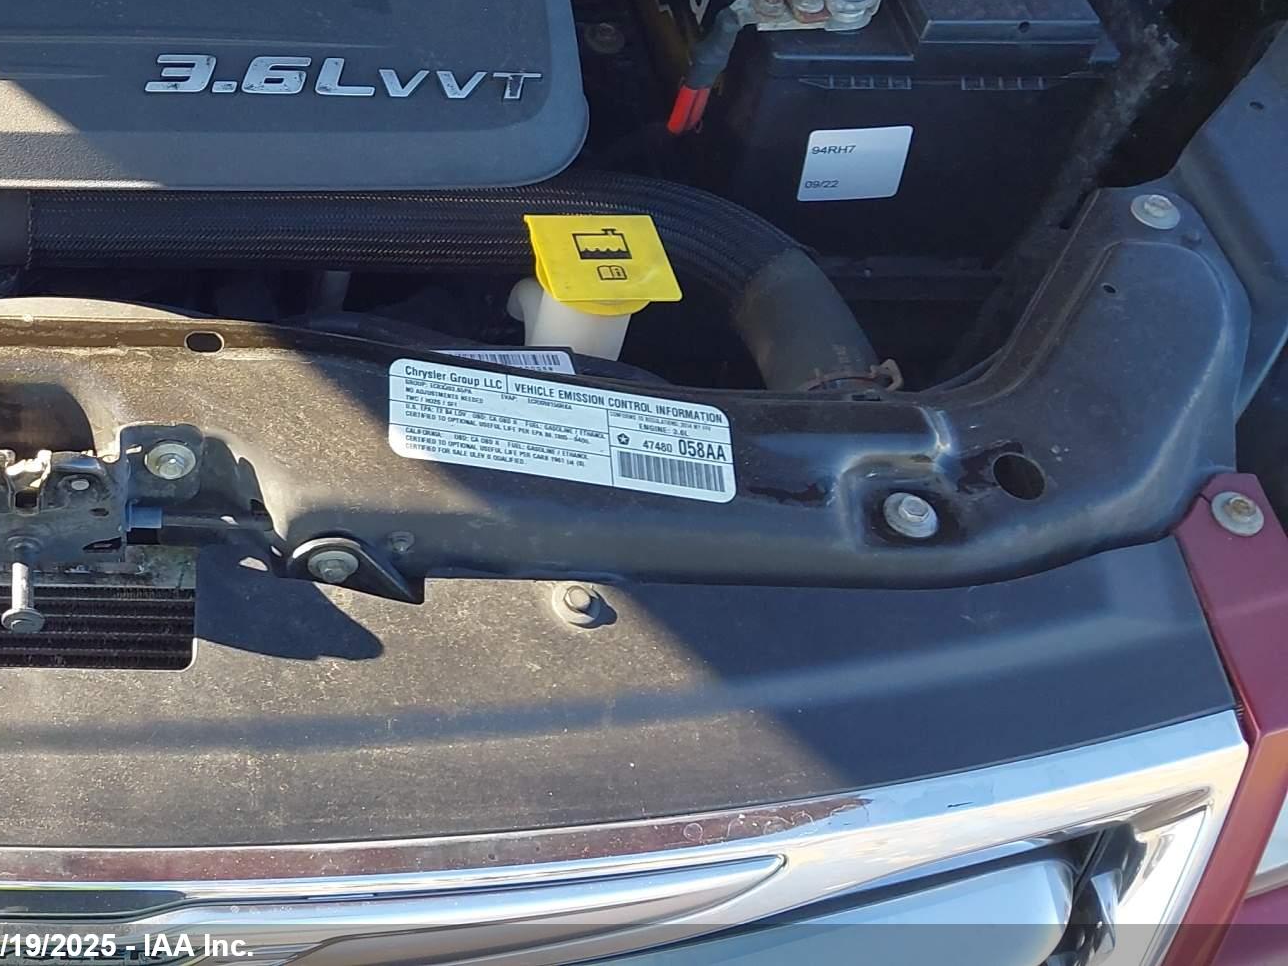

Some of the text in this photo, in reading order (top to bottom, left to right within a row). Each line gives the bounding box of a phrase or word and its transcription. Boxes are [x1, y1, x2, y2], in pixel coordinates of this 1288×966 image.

[811, 144, 856, 155] 94RH7
[804, 179, 840, 189] 09/22
[405, 365, 502, 389] Chrysler Group LLC
[514, 382, 555, 397] VEHICLE
[558, 389, 604, 405] EMISSION
[608, 397, 652, 413] CONTROL
[655, 404, 722, 424] INFORMATION
[642, 439, 672, 452] 47480
[678, 439, 727, 461] 058AA
